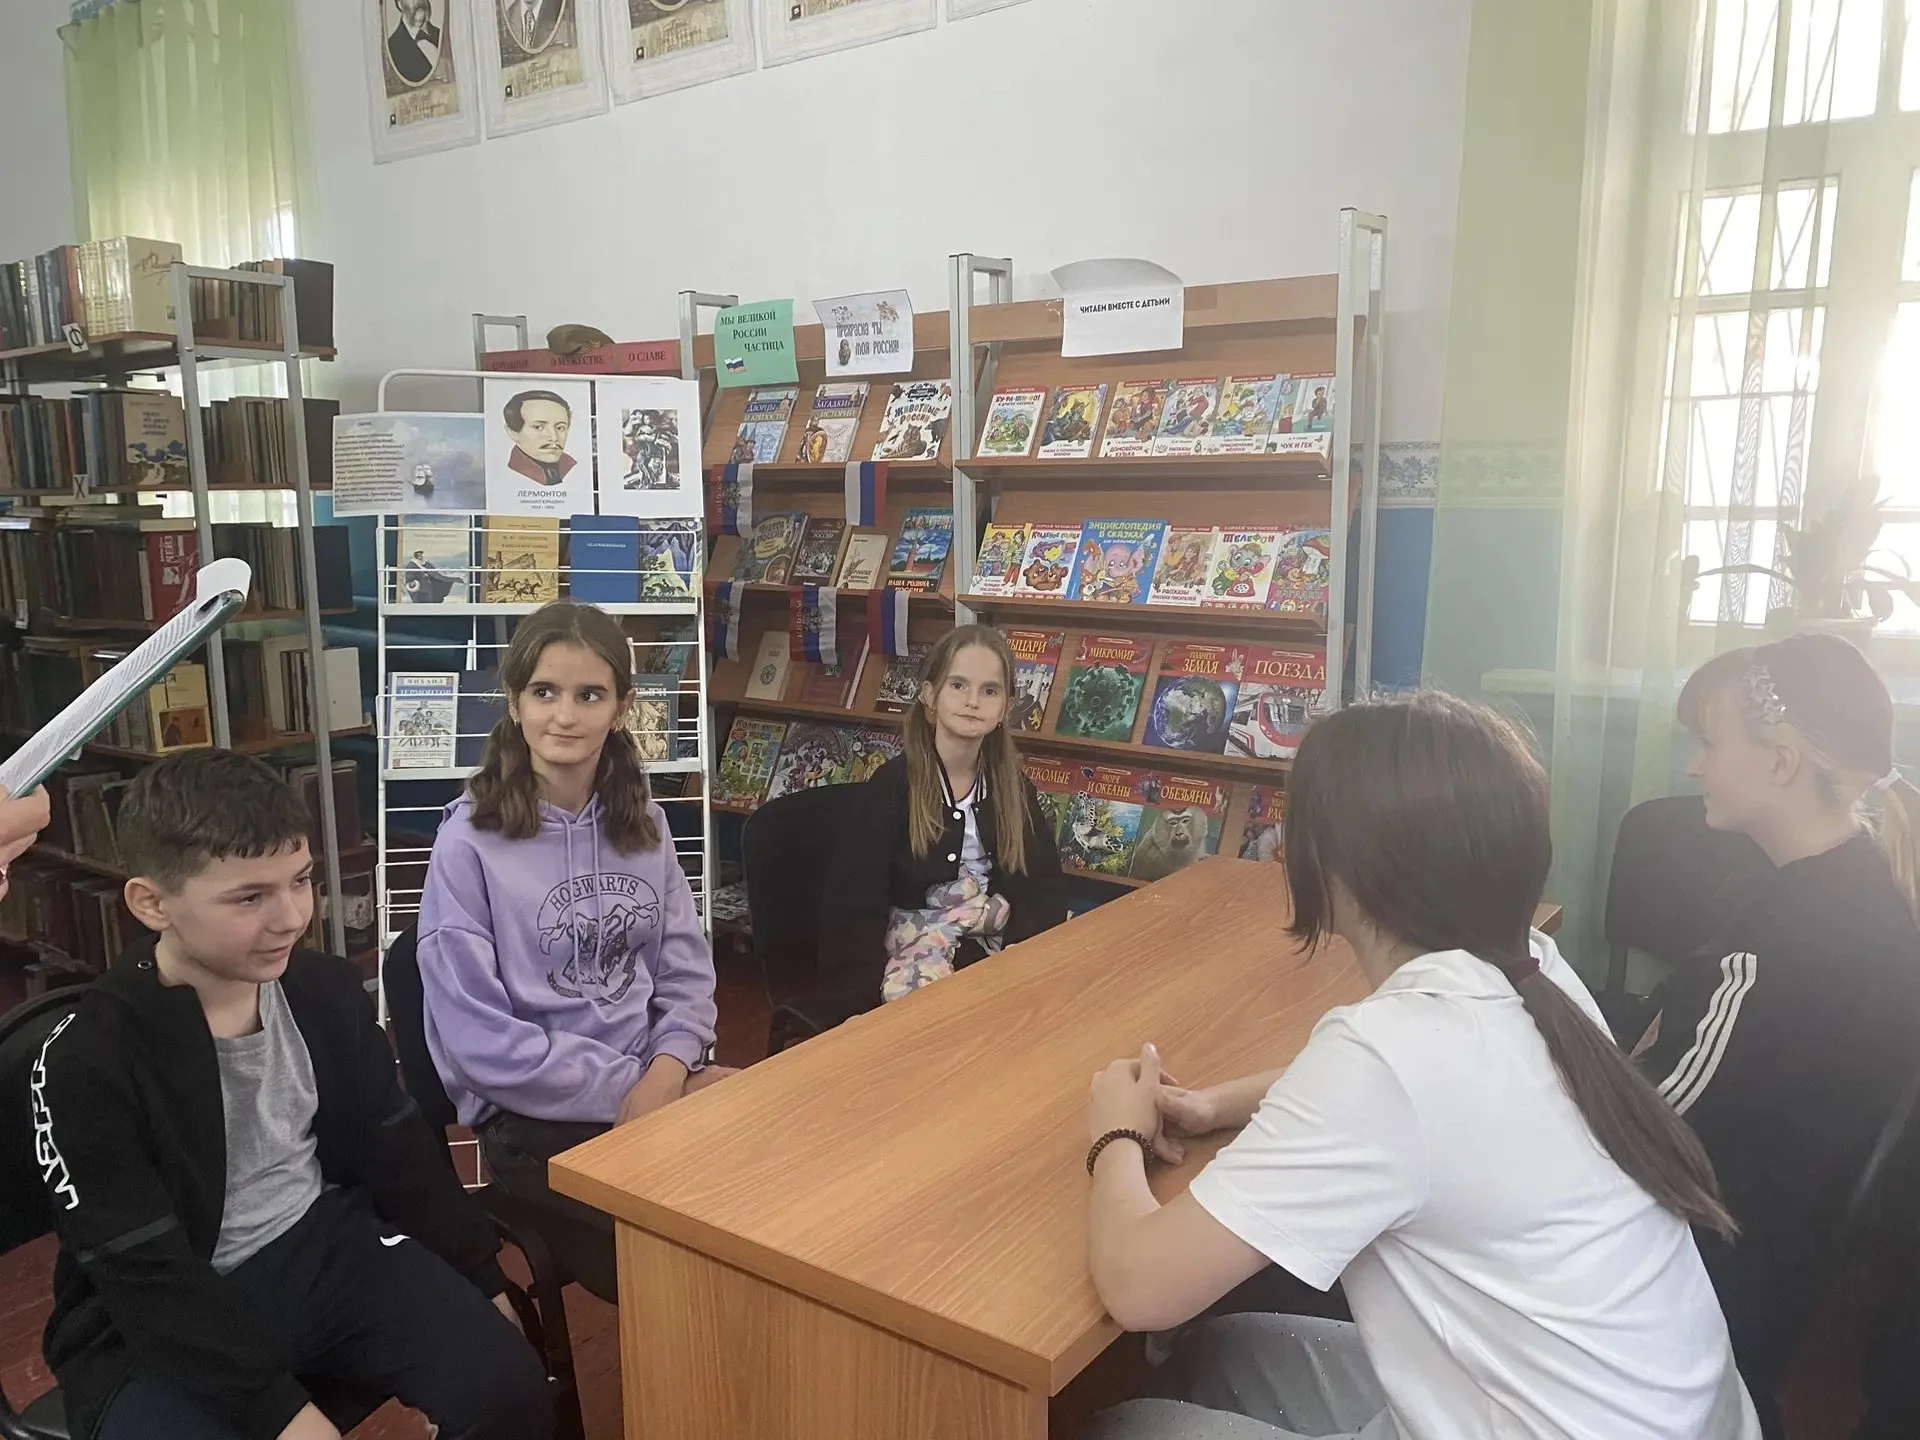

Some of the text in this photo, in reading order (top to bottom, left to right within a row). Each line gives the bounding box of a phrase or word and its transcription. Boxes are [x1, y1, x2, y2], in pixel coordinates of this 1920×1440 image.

[1080, 298, 1170, 313] ЧИТАЕМ ВМЕСТЕ С ДЕТЬМИ
[720, 309, 776, 325] МЫ ВЕЛИКОЙ
[68, 327, 84, 349] Ф
[732, 327, 767, 339] РОССИИ
[744, 341, 784, 352] ЧАСТИЦА
[855, 341, 870, 356] МОЯ
[628, 351, 666, 362] О СЛАВЕ
[894, 403, 941, 417] ЖИВОТНЫЕ
[1088, 521, 1162, 531] ЭНЦИКЛОПЕДИЯ
[1107, 530, 1145, 539] СКАЗКАХ
[1223, 533, 1275, 544] ТЕЛЕФОН
[1007, 639, 1047, 653] РЫЦАРИ
[1089, 647, 1136, 660] МИКРОМИР
[1190, 652, 1216, 660] ПЛАНЕТА
[1182, 658, 1219, 674] ЗЕМЛЯ
[1254, 660, 1325, 680] ПОЕЗДА
[1025, 766, 1071, 785] СЕКОМЫЕ
[1101, 774, 1120, 784] МОРЯ
[1087, 781, 1131, 797] И ОКЕАНЫ
[1160, 785, 1212, 805] ОБЕЗЬЯНЫ
[550, 876, 639, 911] HOGWARTS
